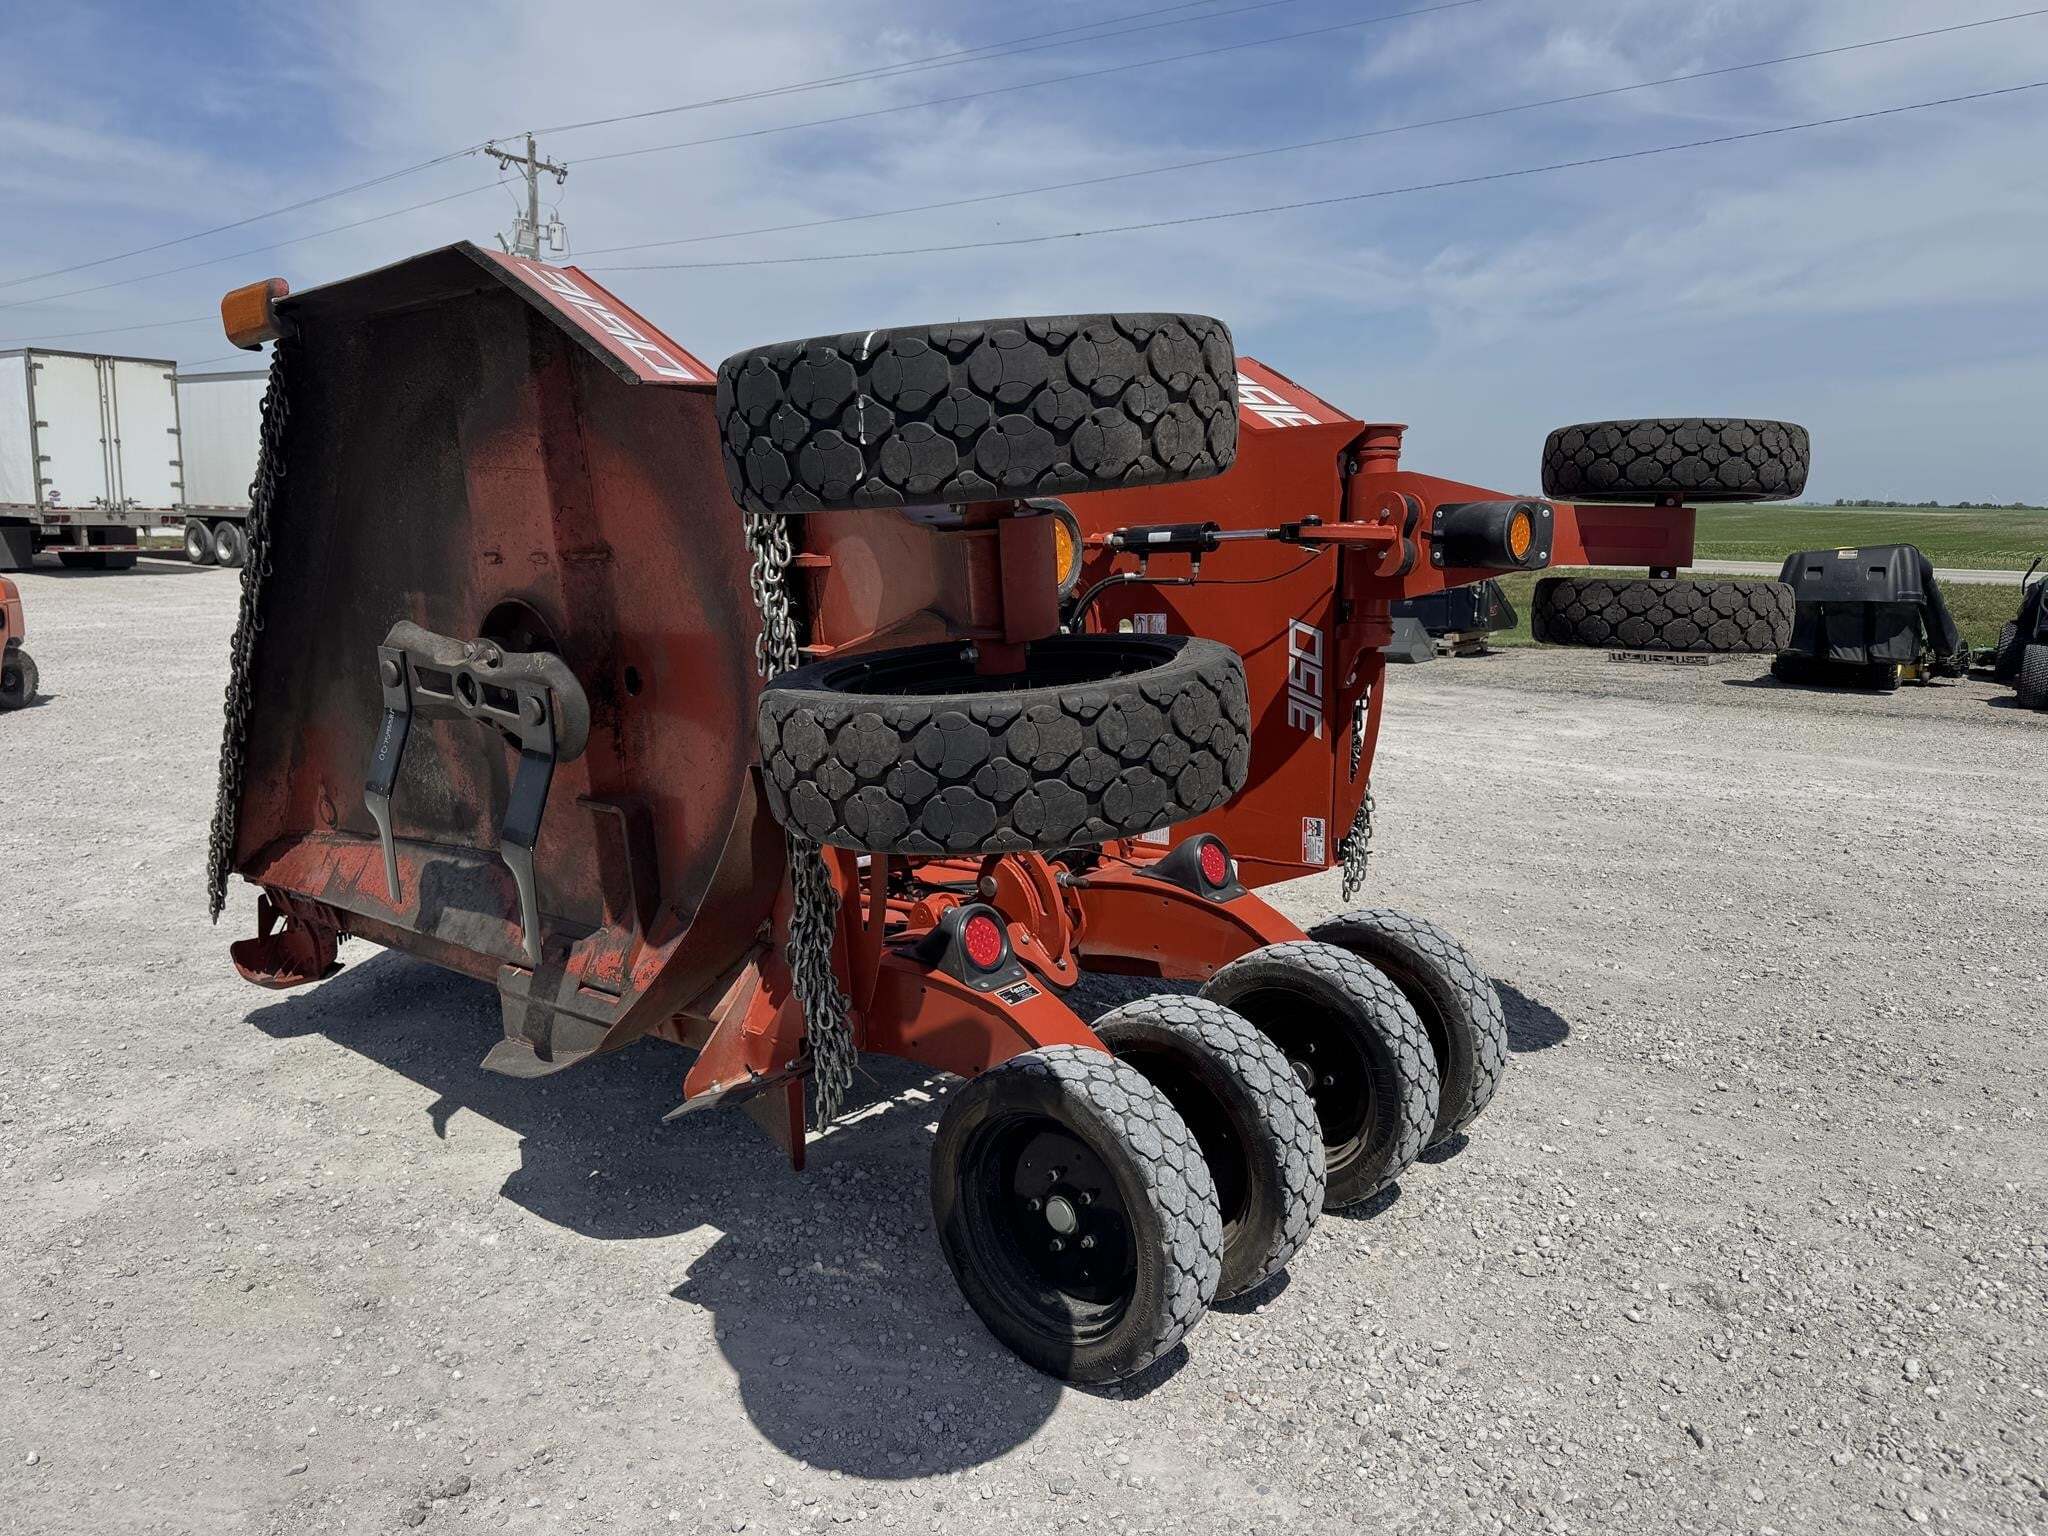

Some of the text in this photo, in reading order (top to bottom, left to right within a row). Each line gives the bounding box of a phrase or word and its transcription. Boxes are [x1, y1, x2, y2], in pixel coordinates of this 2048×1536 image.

[516, 262, 698, 381] 3150
[1237, 371, 1323, 428] 315
[1288, 617, 1324, 740] 3150
